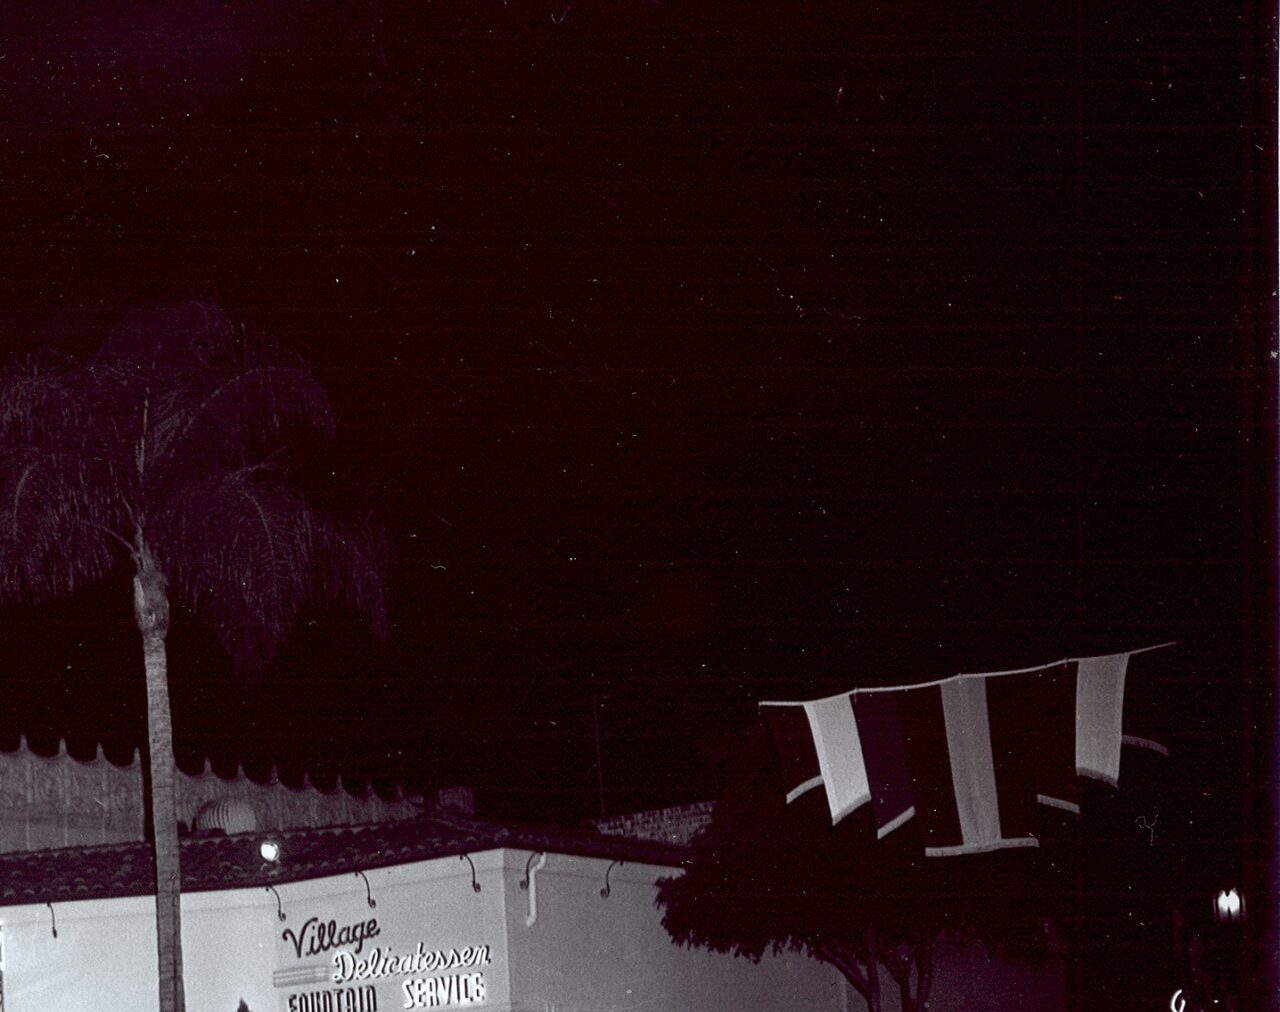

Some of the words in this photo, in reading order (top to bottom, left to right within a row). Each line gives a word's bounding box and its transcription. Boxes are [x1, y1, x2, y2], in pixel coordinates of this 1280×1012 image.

[282, 917, 381, 959] Village
[331, 942, 492, 984] Delicatessen
[401, 972, 488, 1012] SERVICE
